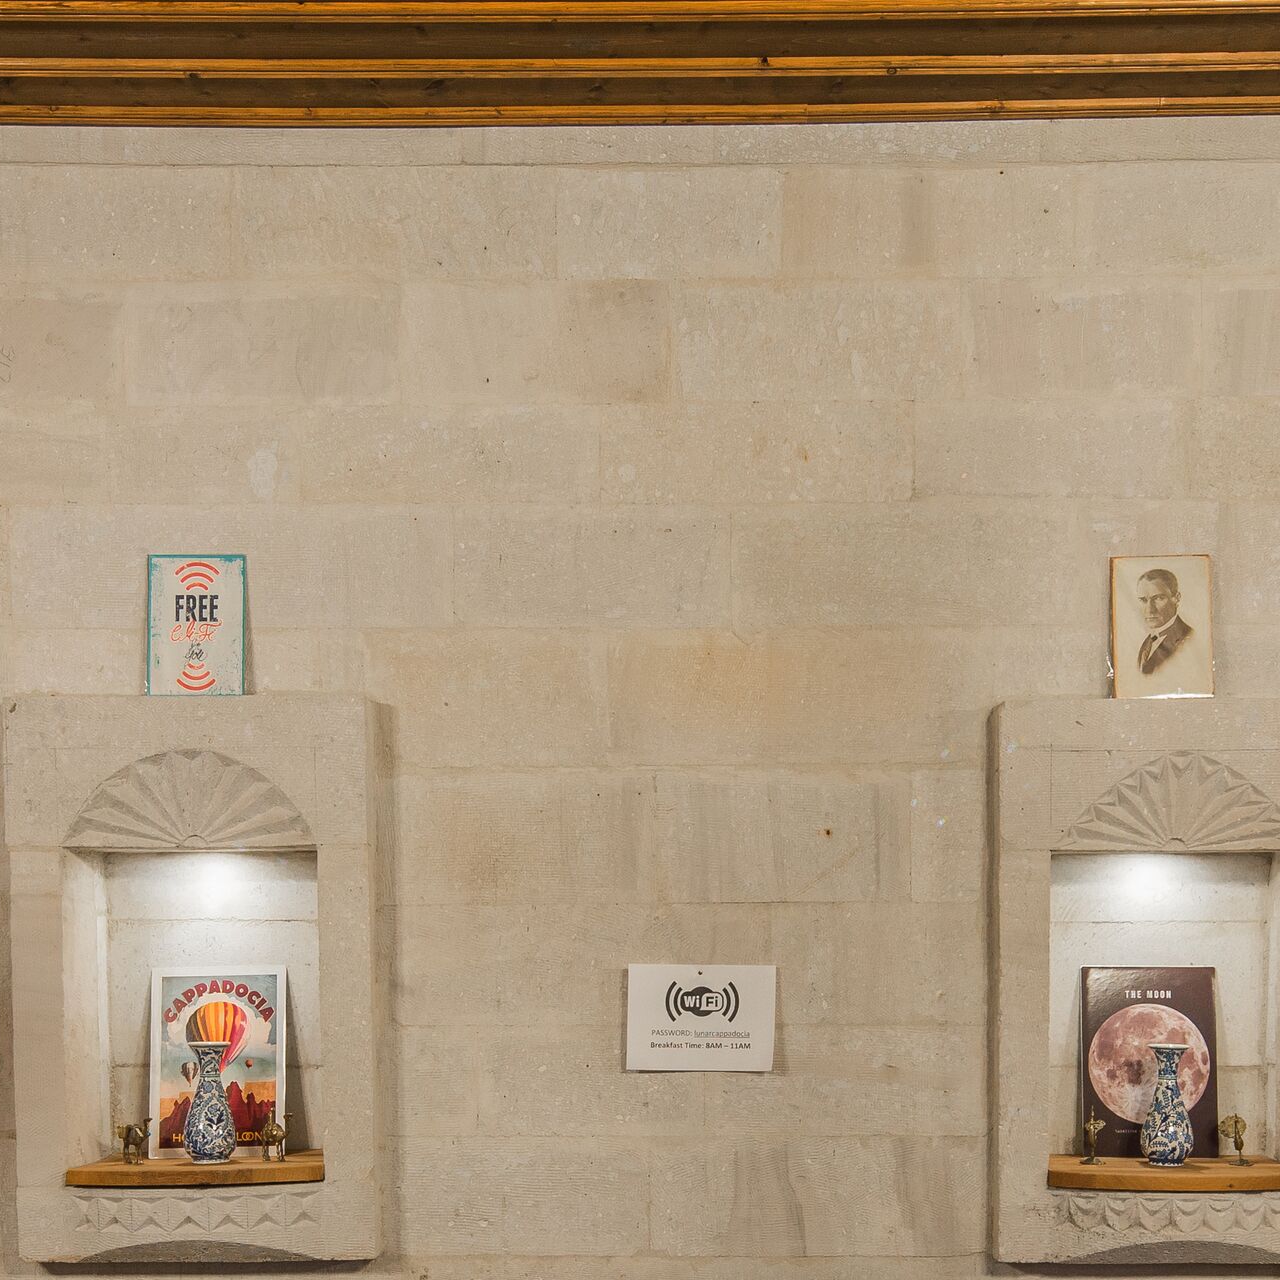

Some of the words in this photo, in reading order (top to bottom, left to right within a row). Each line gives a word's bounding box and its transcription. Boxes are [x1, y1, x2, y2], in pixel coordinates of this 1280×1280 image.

[175, 595, 218, 622] FREE
[163, 979, 276, 1024] CAPPADOCIA
[1125, 990, 1141, 998] THE
[1147, 990, 1172, 998] MOON
[694, 1030, 750, 1038] lunarcappadocia
